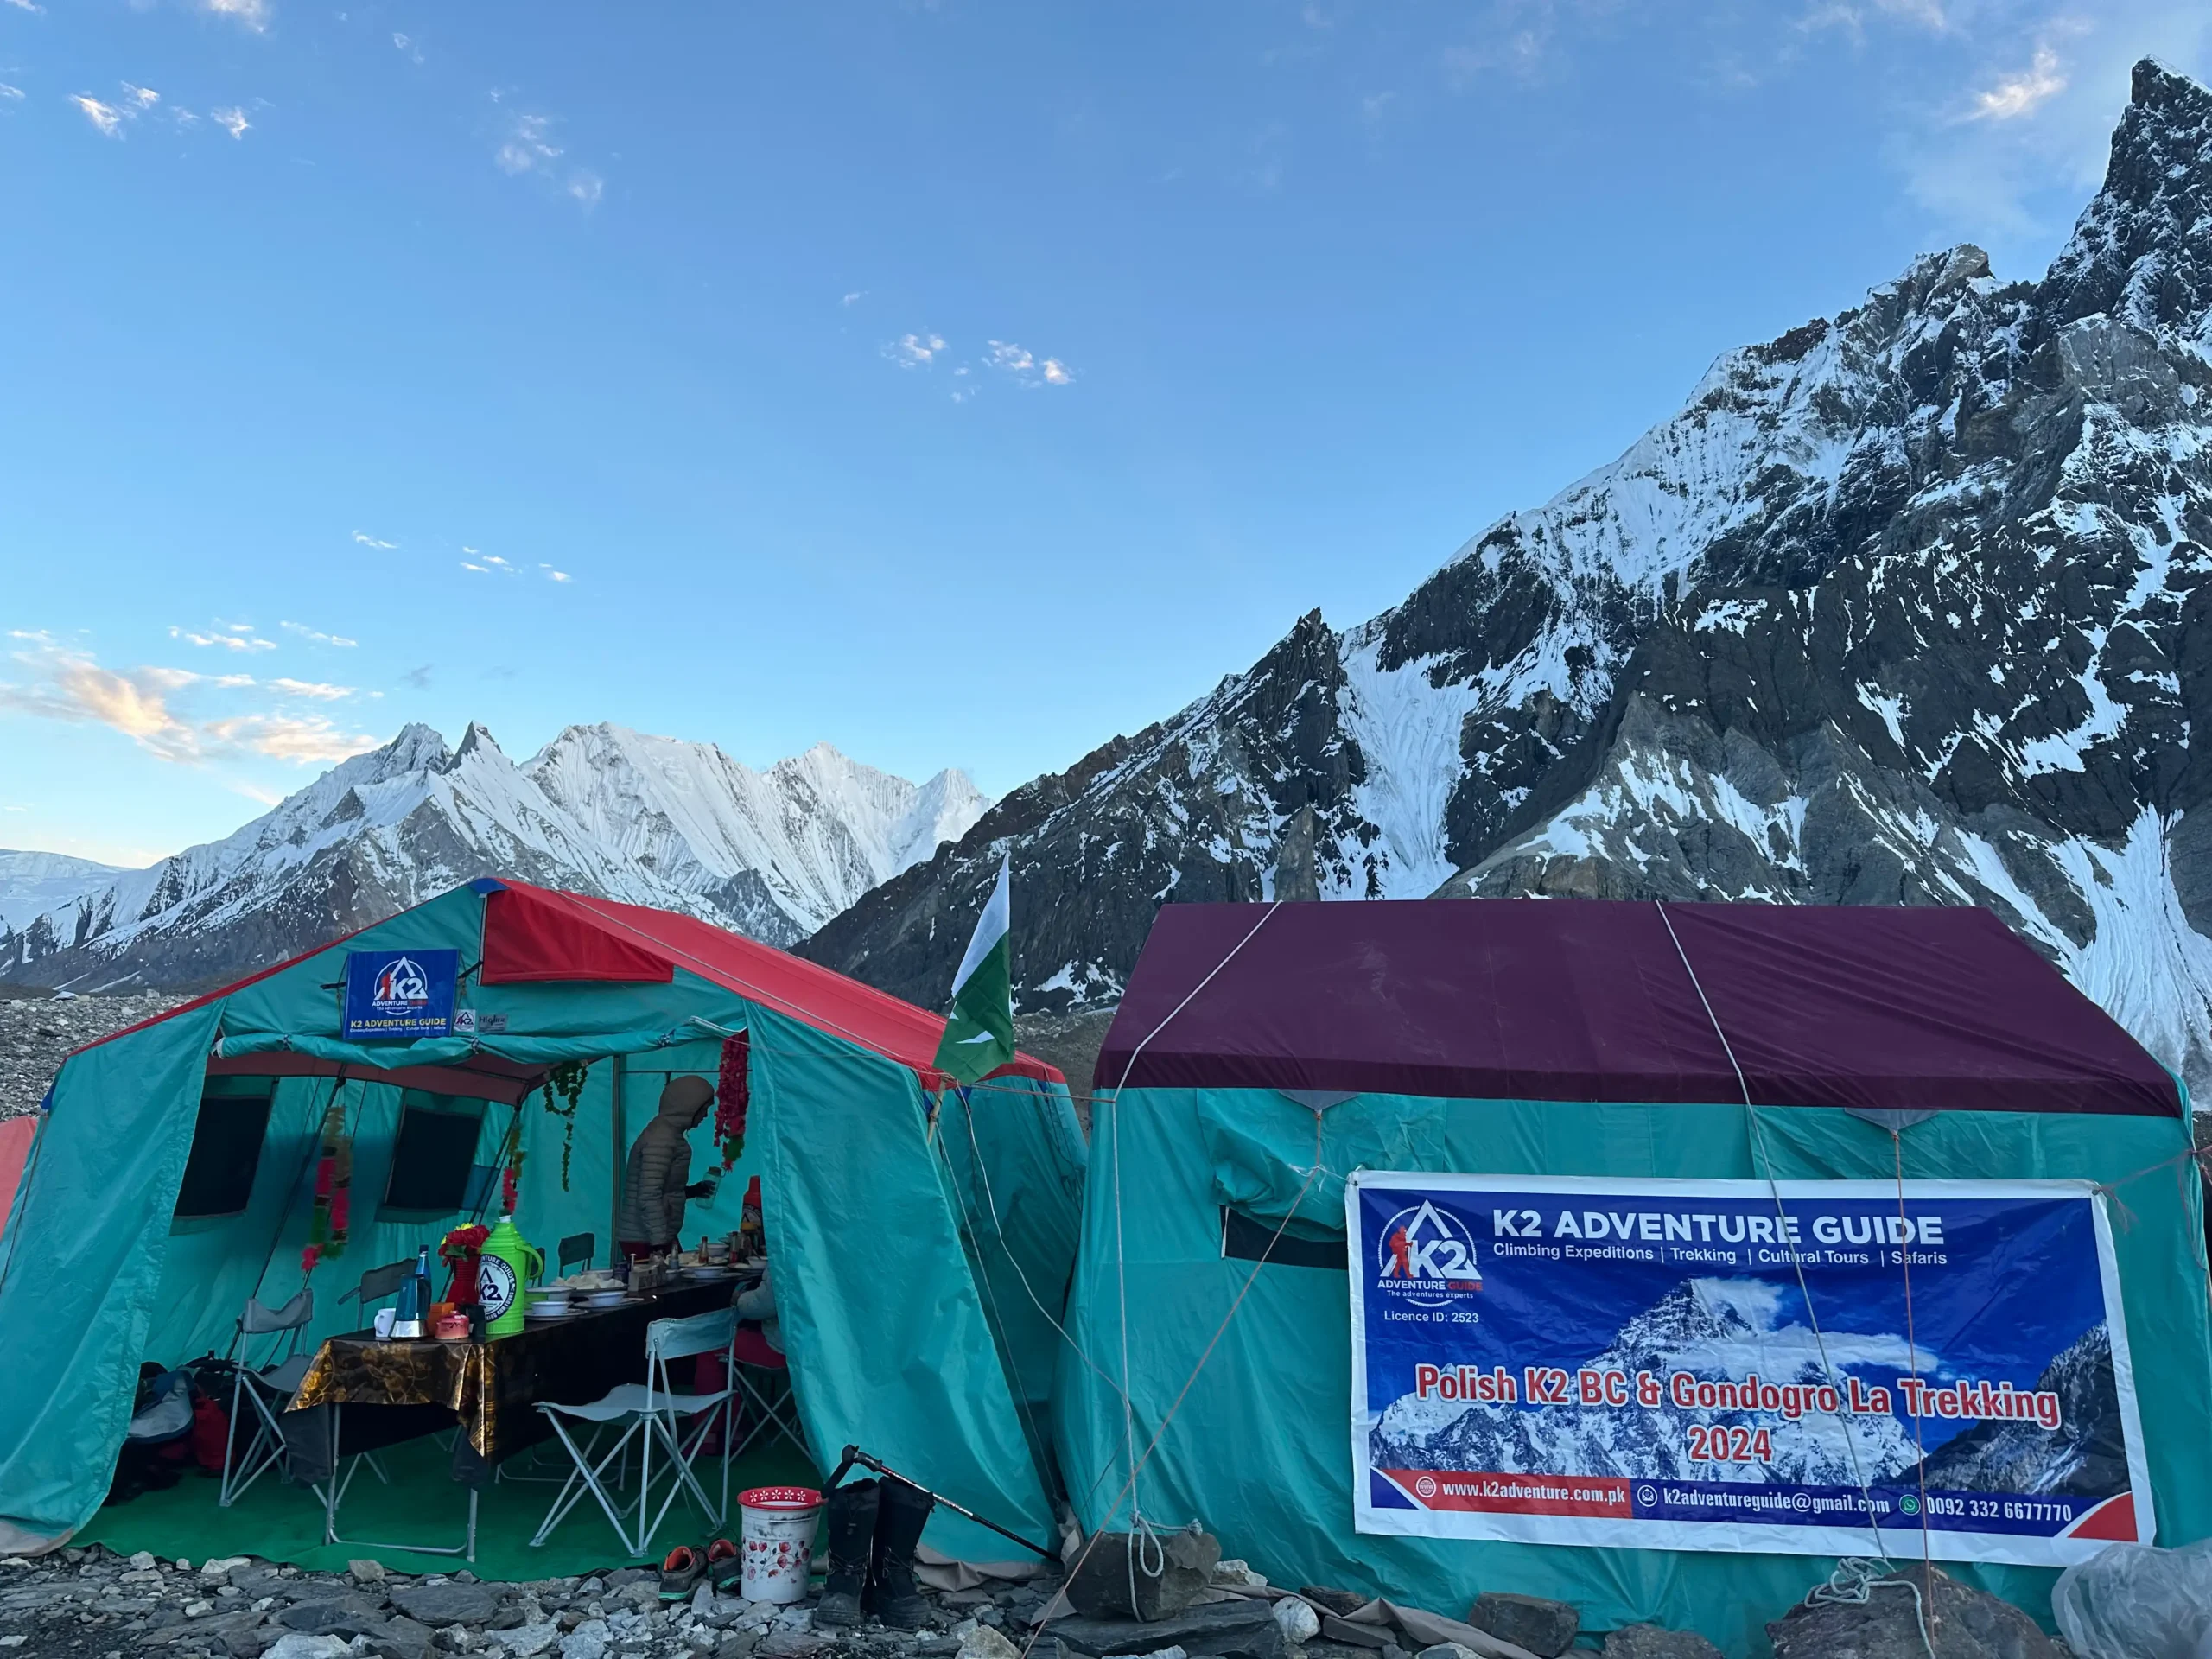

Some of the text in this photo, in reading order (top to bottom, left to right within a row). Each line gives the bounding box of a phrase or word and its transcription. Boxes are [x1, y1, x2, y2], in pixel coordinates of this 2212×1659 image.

[390, 977, 429, 1000] K2
[364, 1019, 416, 1027] ADVENTURE
[1493, 1209, 1944, 1245] K2 ADVENTURE GUIDE
[1409, 1239, 1483, 1280] K2
[1493, 1243, 1948, 1265] Climbing Expeditions Trekking Cultural Tours Safaris
[500, 1263, 515, 1283] GUIDE
[480, 1283, 504, 1300] K2
[1377, 1280, 1483, 1291] ADVENTURE GUIDE
[1384, 1310, 1479, 1323] Licence ID: 2523
[1415, 1363, 2062, 1430] Polish K2 BC & Gondogro La Trekking
[1687, 1424, 1772, 1464] 2024
[1442, 1481, 1625, 1505] www.k2adventure.com.pk
[1663, 1488, 1891, 1514] k2adventureguide@gmail.com
[1926, 1497, 2072, 1522] 0092 332 6677770
